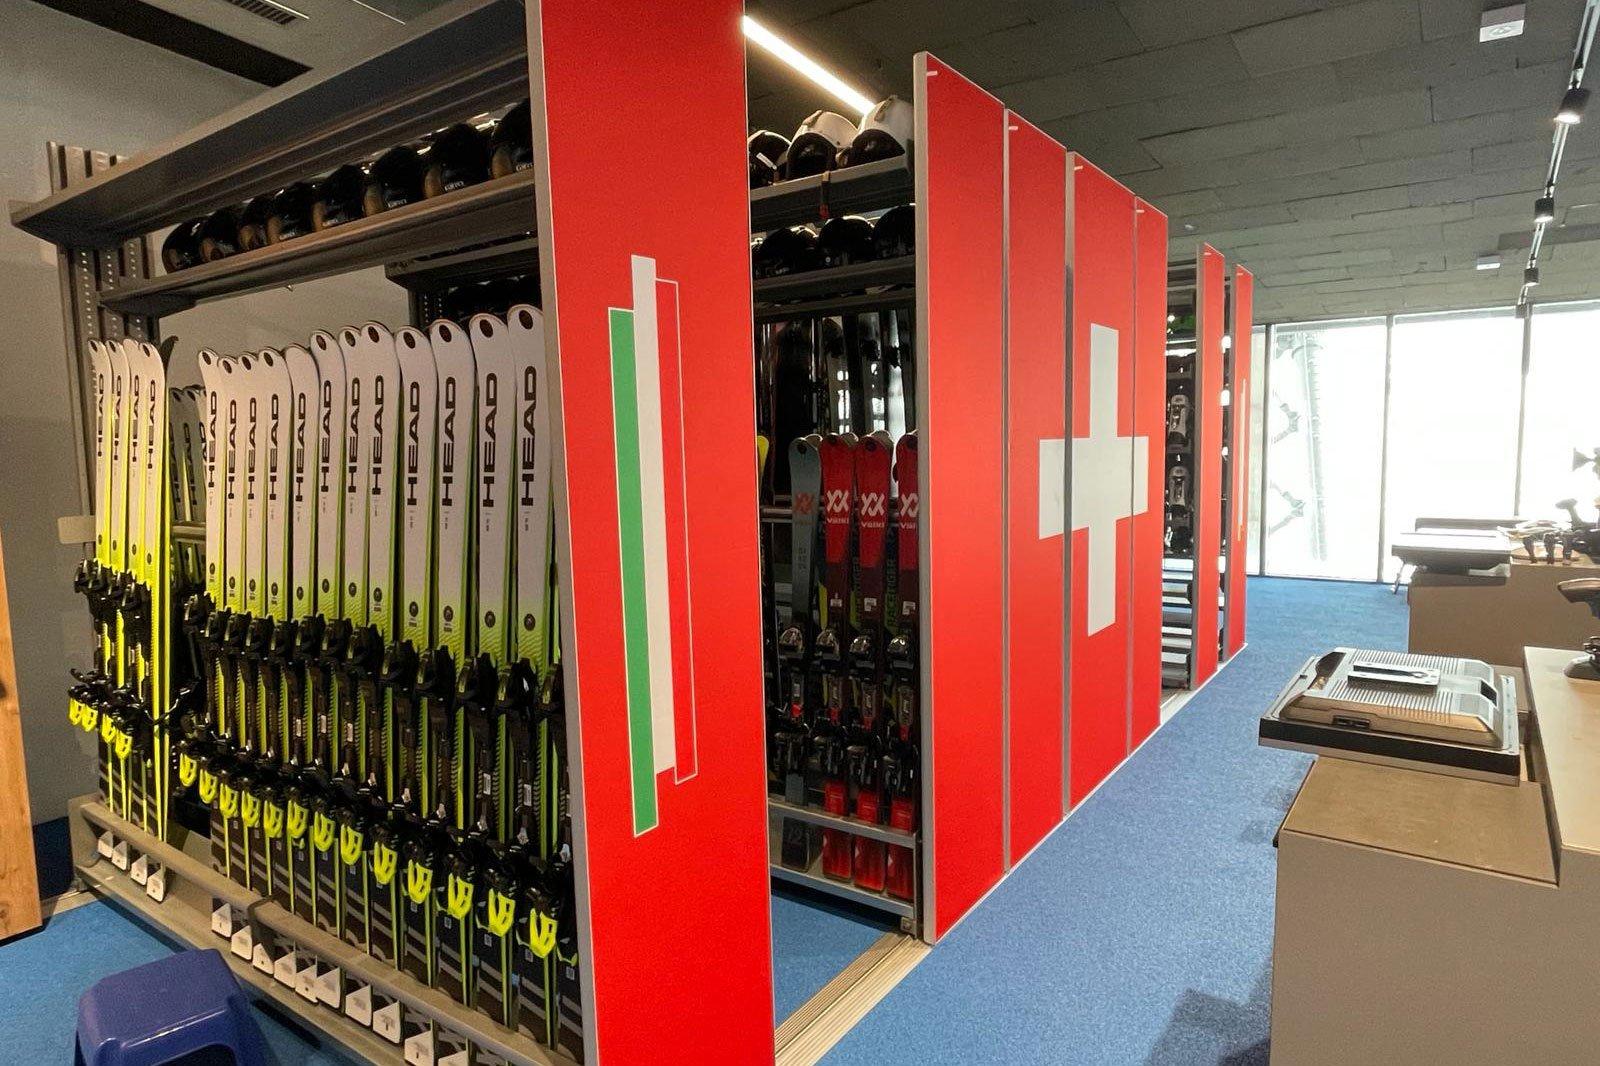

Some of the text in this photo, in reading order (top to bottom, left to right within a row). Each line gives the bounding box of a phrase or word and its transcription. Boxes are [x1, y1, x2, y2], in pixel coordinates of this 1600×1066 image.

[208, 391, 216, 487] HEAD
[228, 399, 236, 499] HEAD
[248, 397, 256, 499] HEAD
[270, 394, 278, 500] HEAD
[296, 392, 306, 502] HEAD
[320, 380, 331, 493] HEAD
[348, 377, 360, 493] HEAD
[372, 375, 384, 495] HEAD
[407, 381, 420, 506] HEAD
[442, 376, 456, 507] HEAD
[482, 372, 497, 508] HEAD
[521, 366, 537, 507] HEAD
